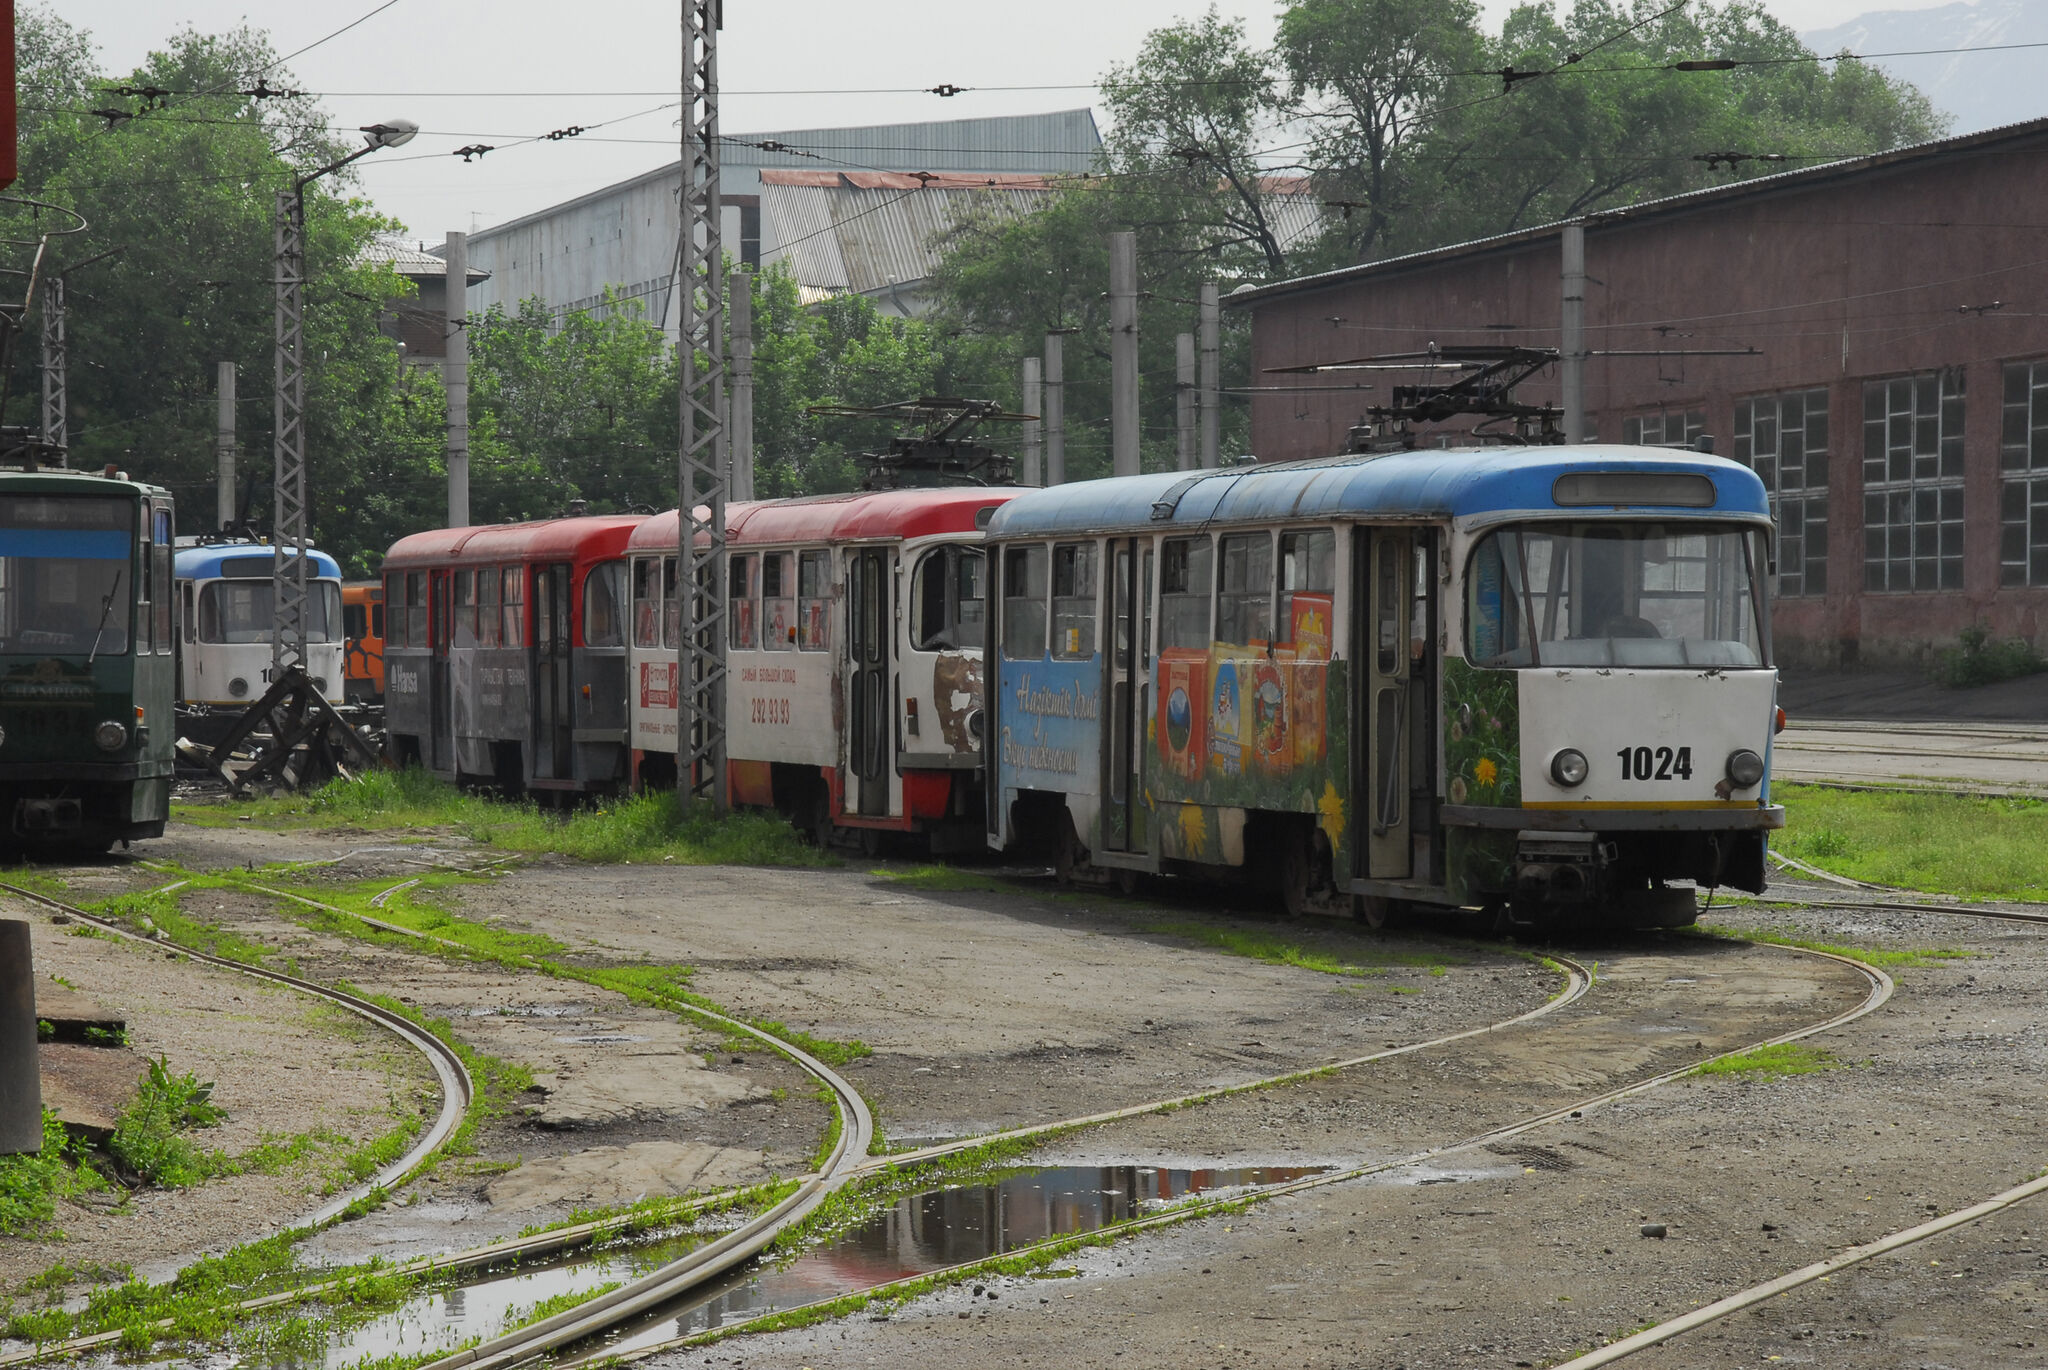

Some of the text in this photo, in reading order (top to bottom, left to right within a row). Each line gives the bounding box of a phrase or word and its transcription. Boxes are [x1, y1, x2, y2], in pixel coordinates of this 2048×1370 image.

[397, 664, 418, 693] Hansa
[742, 666, 796, 684] САМЫЙ БОЛЬШОЙ СКЛАД
[751, 698, 790, 725] 292 93 93
[1002, 725, 1026, 779] Вкус
[1617, 746, 1693, 781] 1024
